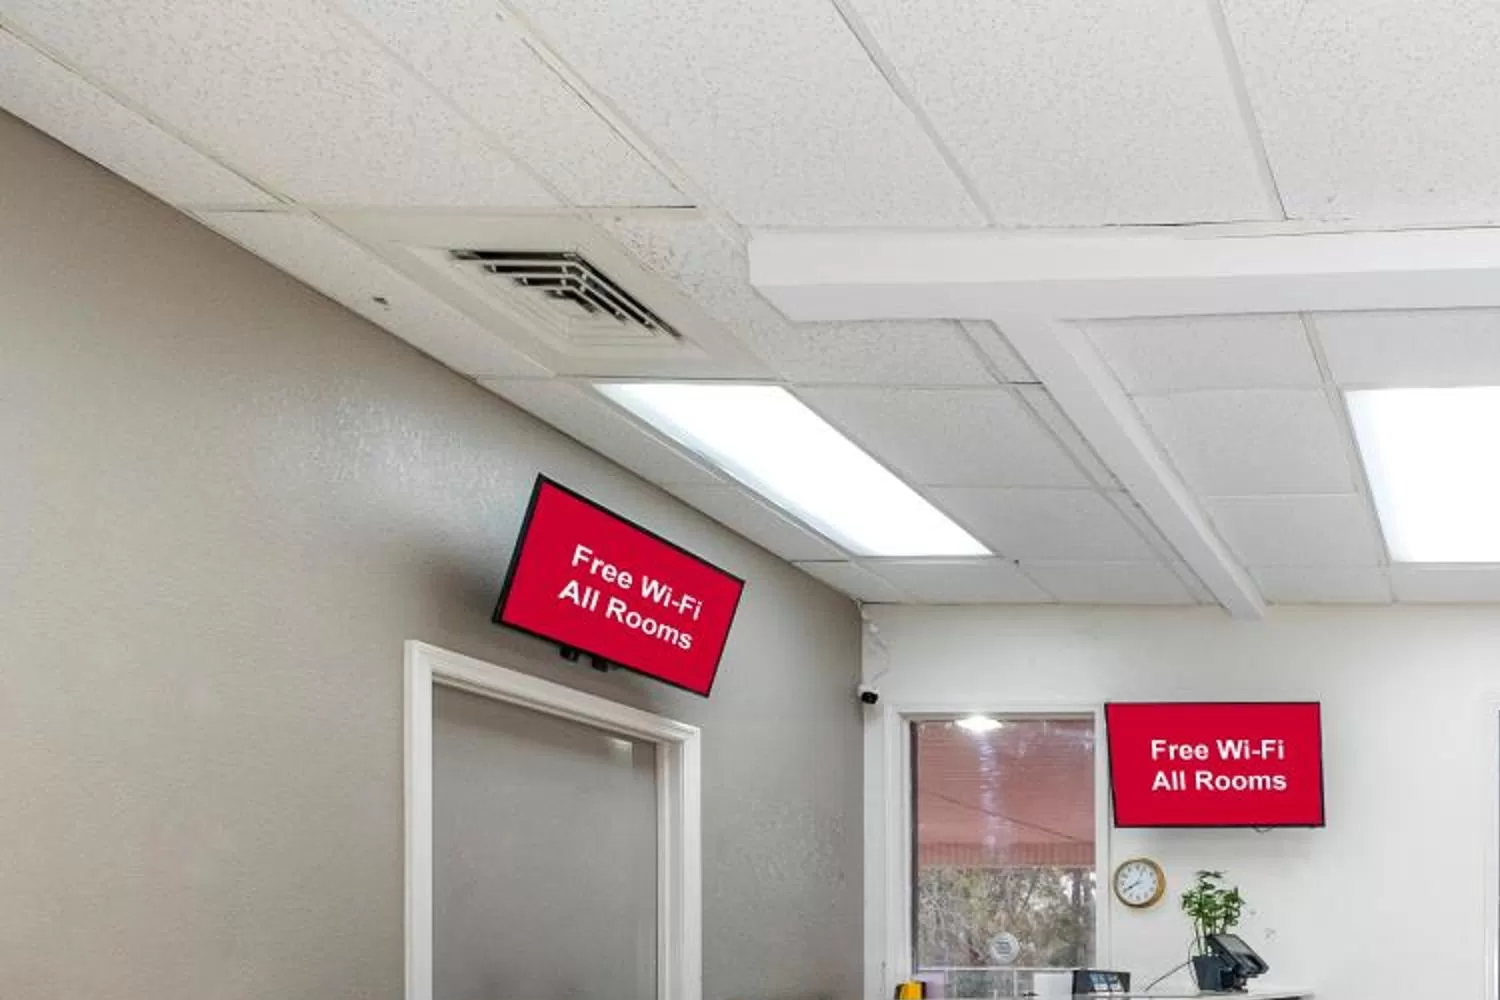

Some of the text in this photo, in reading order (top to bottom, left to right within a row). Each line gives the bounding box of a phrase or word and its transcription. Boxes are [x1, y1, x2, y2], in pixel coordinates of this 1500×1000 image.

[571, 543, 703, 621] Free Wi-Fi
[558, 579, 693, 650] All Rooms
[1151, 739, 1285, 761] Free Wi-Fi
[1151, 770, 1287, 791] All Rooms
